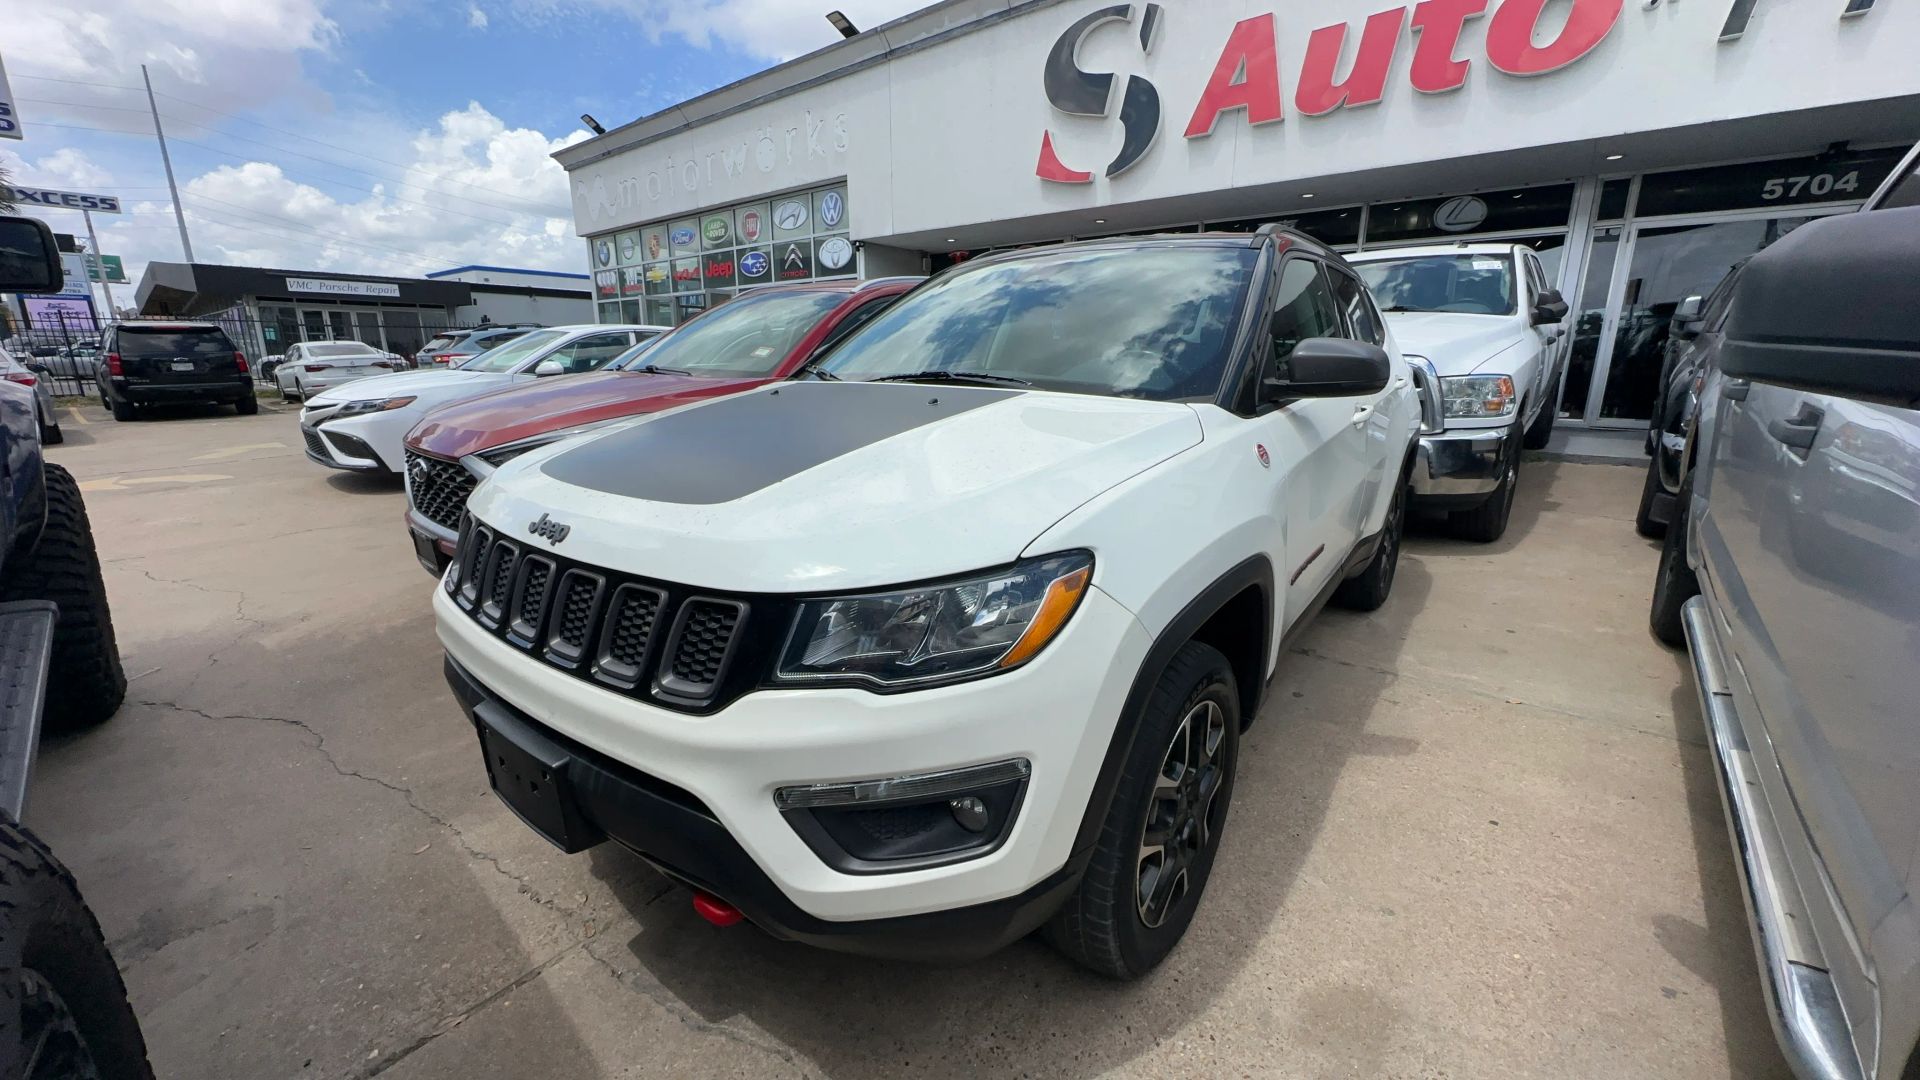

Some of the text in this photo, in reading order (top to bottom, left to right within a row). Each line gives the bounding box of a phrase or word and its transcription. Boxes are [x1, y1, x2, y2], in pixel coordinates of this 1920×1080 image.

[1184, 0, 1627, 139] Auto
[1761, 170, 1859, 200] 5704
[704, 260, 733, 278] Jeep
[288, 280, 398, 295] VMC Porsche Repair
[528, 513, 571, 546] Jeep
